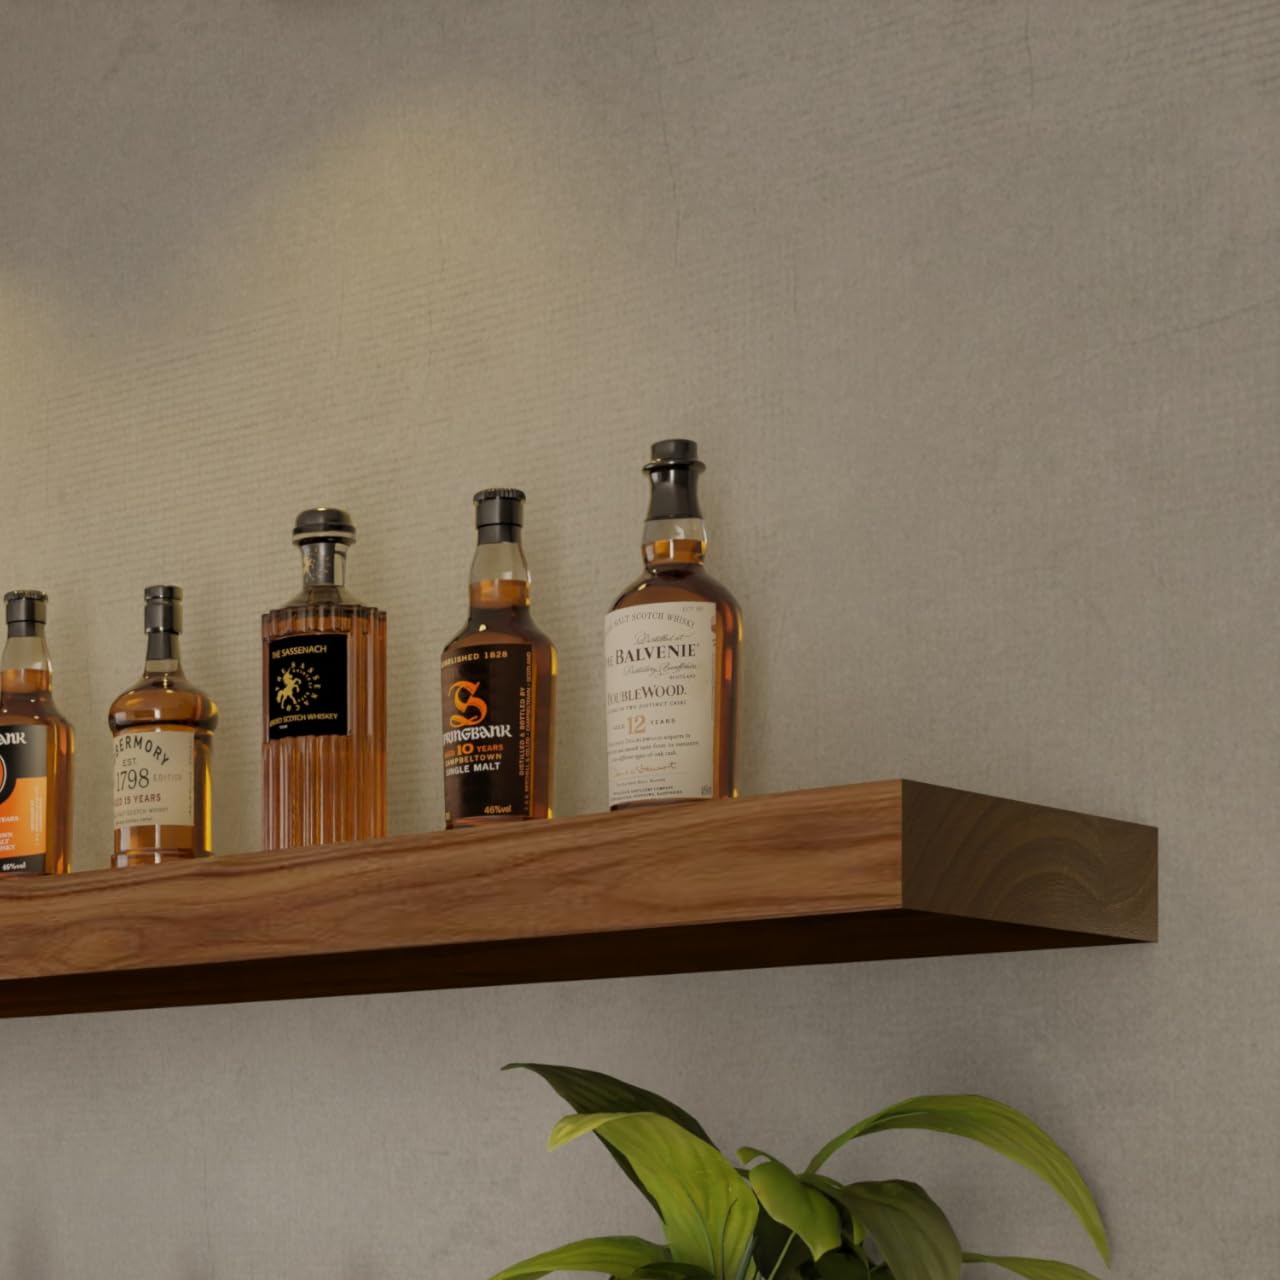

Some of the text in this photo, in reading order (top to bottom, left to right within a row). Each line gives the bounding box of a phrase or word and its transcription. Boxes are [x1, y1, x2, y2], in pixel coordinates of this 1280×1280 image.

[631, 611, 665, 622] SCOTCH
[667, 613, 696, 630] WHISKY
[281, 644, 328, 657] SASSENACH
[615, 643, 697, 665] BALVENIE
[626, 714, 647, 736] 12
[650, 718, 677, 726] YEARS
[114, 735, 170, 766] BERMORY
[457, 743, 475, 757] 10
[476, 743, 505, 753] YEARS
[473, 761, 502, 772] MALT
[116, 767, 150, 793] 1798
[133, 793, 161, 804] YEARS
